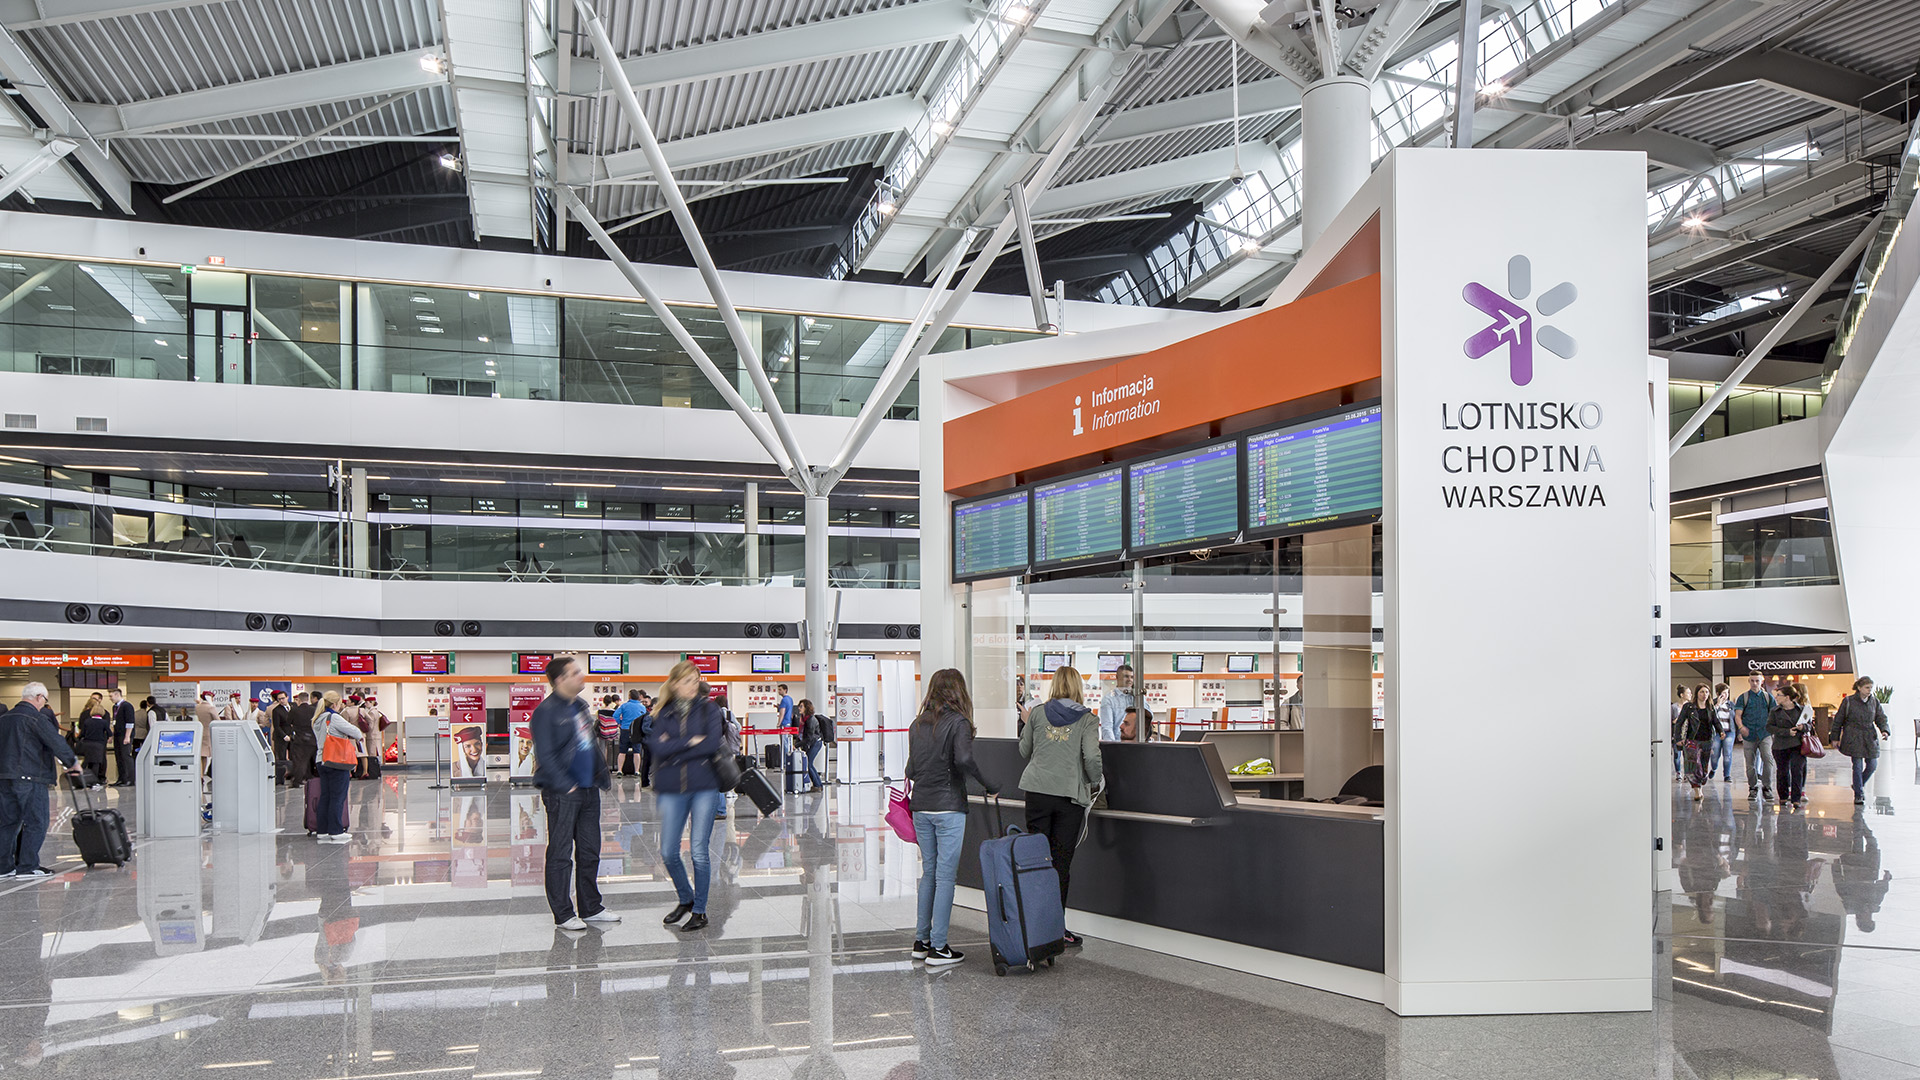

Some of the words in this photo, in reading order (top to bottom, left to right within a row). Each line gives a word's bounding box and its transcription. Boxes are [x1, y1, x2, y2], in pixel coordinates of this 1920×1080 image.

[1092, 374, 1154, 408] Informacja
[1092, 399, 1160, 430] Information
[1442, 402, 1603, 430] LOTNISKO
[1442, 445, 1606, 473] CHOPINA
[1442, 485, 1606, 508] WARSZAWA
[170, 651, 190, 673] B
[1822, 657, 1834, 669] illy
